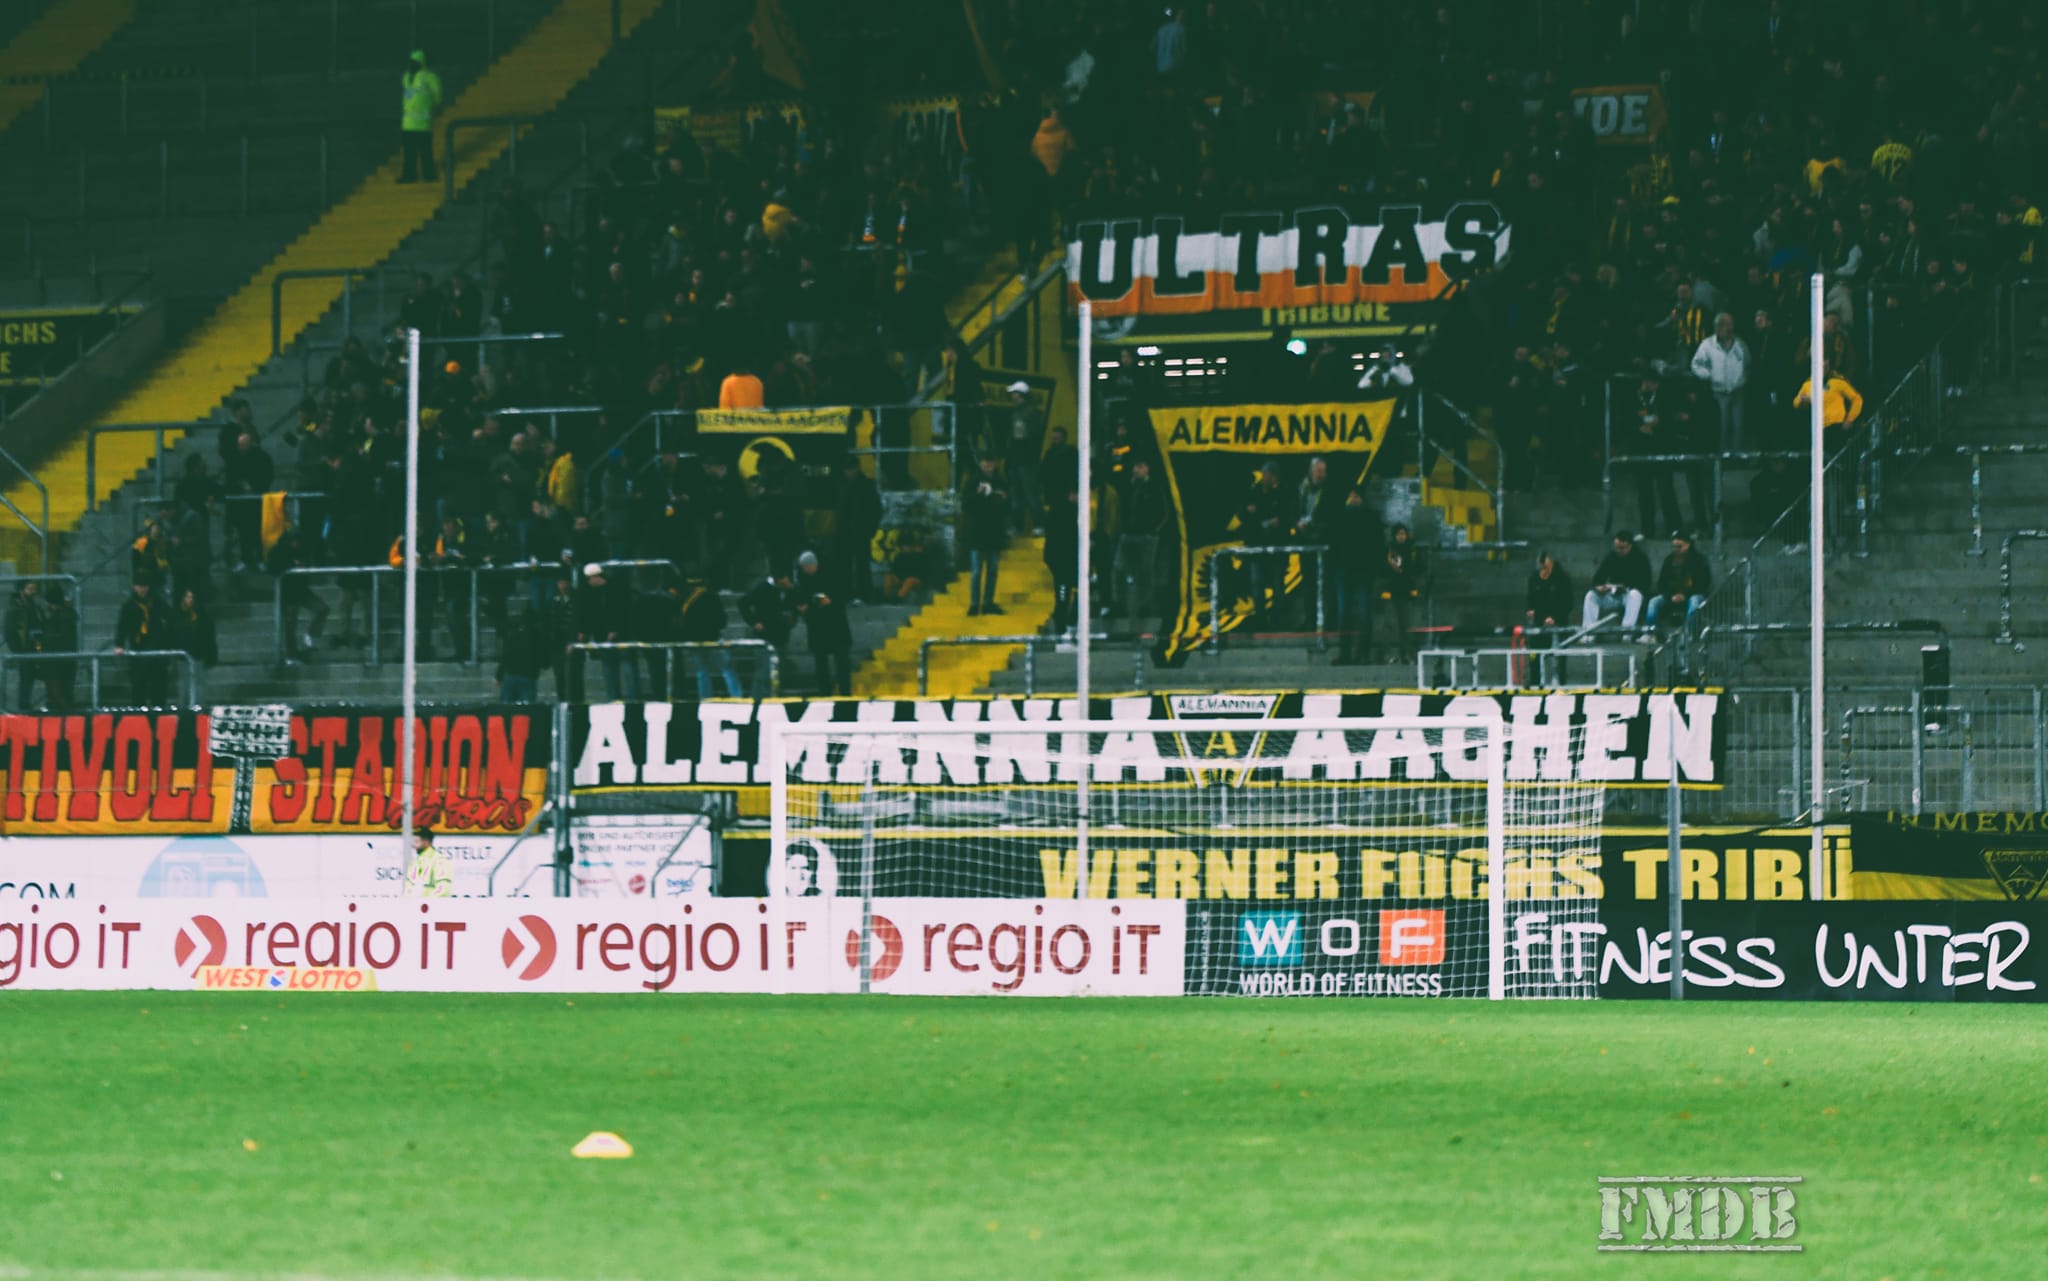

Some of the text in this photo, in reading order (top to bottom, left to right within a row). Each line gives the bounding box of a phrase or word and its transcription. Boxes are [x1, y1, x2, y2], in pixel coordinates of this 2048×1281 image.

[1075, 202, 1502, 303] ULTRAS
[0, 321, 57, 346] CHS
[1169, 413, 1374, 445] ALEMANNIA
[1178, 699, 1267, 710] ALEMANNIA
[0, 714, 531, 825] TIVOLI STADION
[574, 694, 1719, 785] ALEMANNIA AACHEN
[1039, 848, 1340, 899] WERNER
[1361, 848, 1605, 900] FUCHS
[98, 904, 142, 969] iT
[246, 903, 467, 970] regio iT
[576, 904, 740, 990] regio
[923, 904, 1092, 992] regio
[1112, 905, 1161, 975] iT
[1513, 913, 2037, 991] FITNESS UNTER
[205, 968, 363, 990] WEST LOTTO
[1240, 972, 1442, 996] WORLD OF FITNESS
